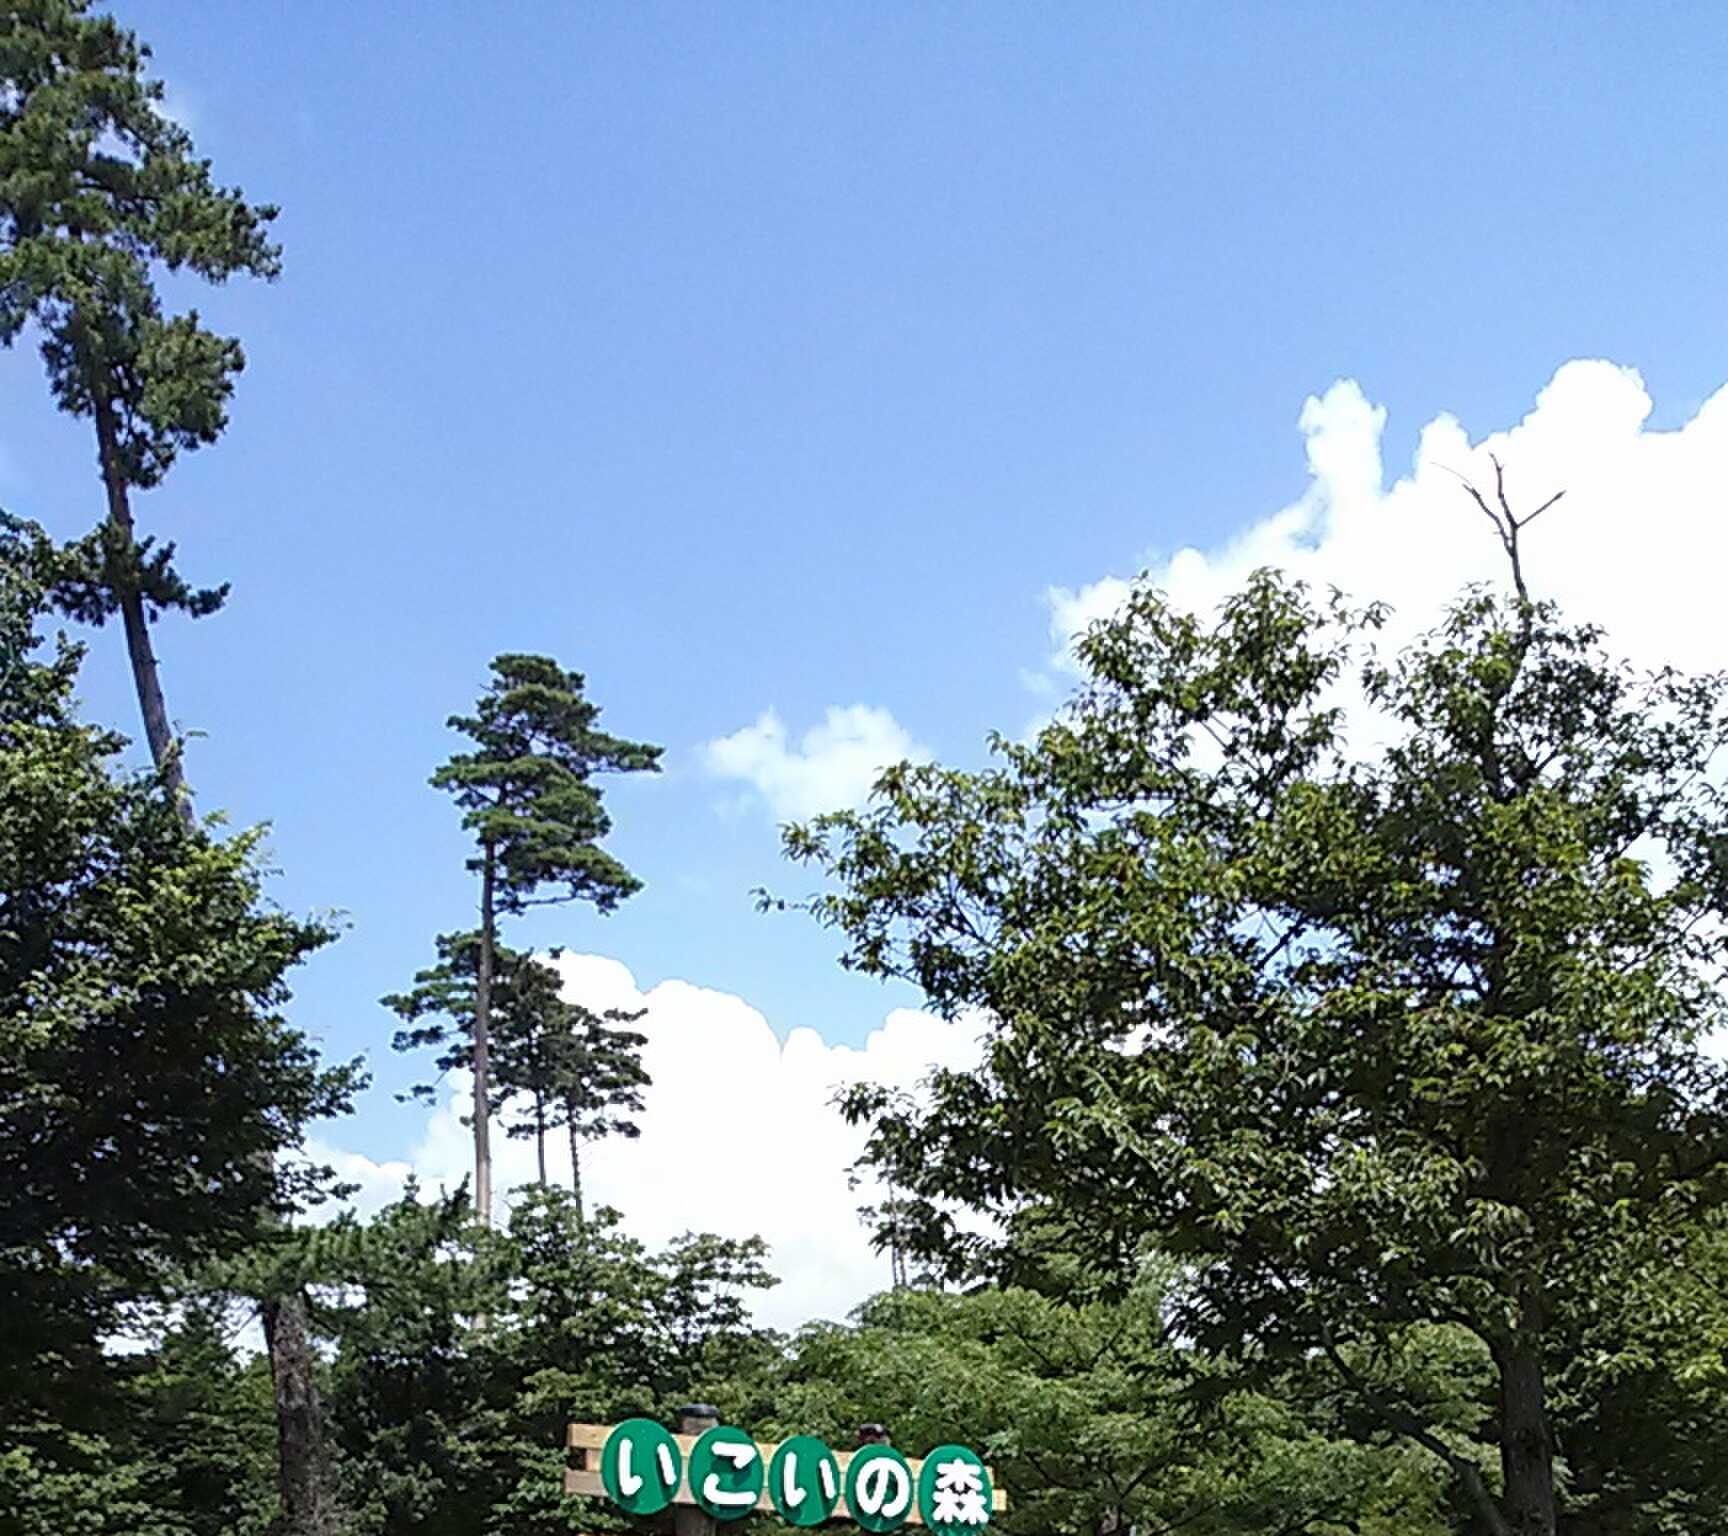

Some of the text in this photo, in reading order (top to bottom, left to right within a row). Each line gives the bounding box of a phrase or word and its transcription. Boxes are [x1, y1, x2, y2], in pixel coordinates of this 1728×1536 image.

[618, 1438, 989, 1525] いこいの森
